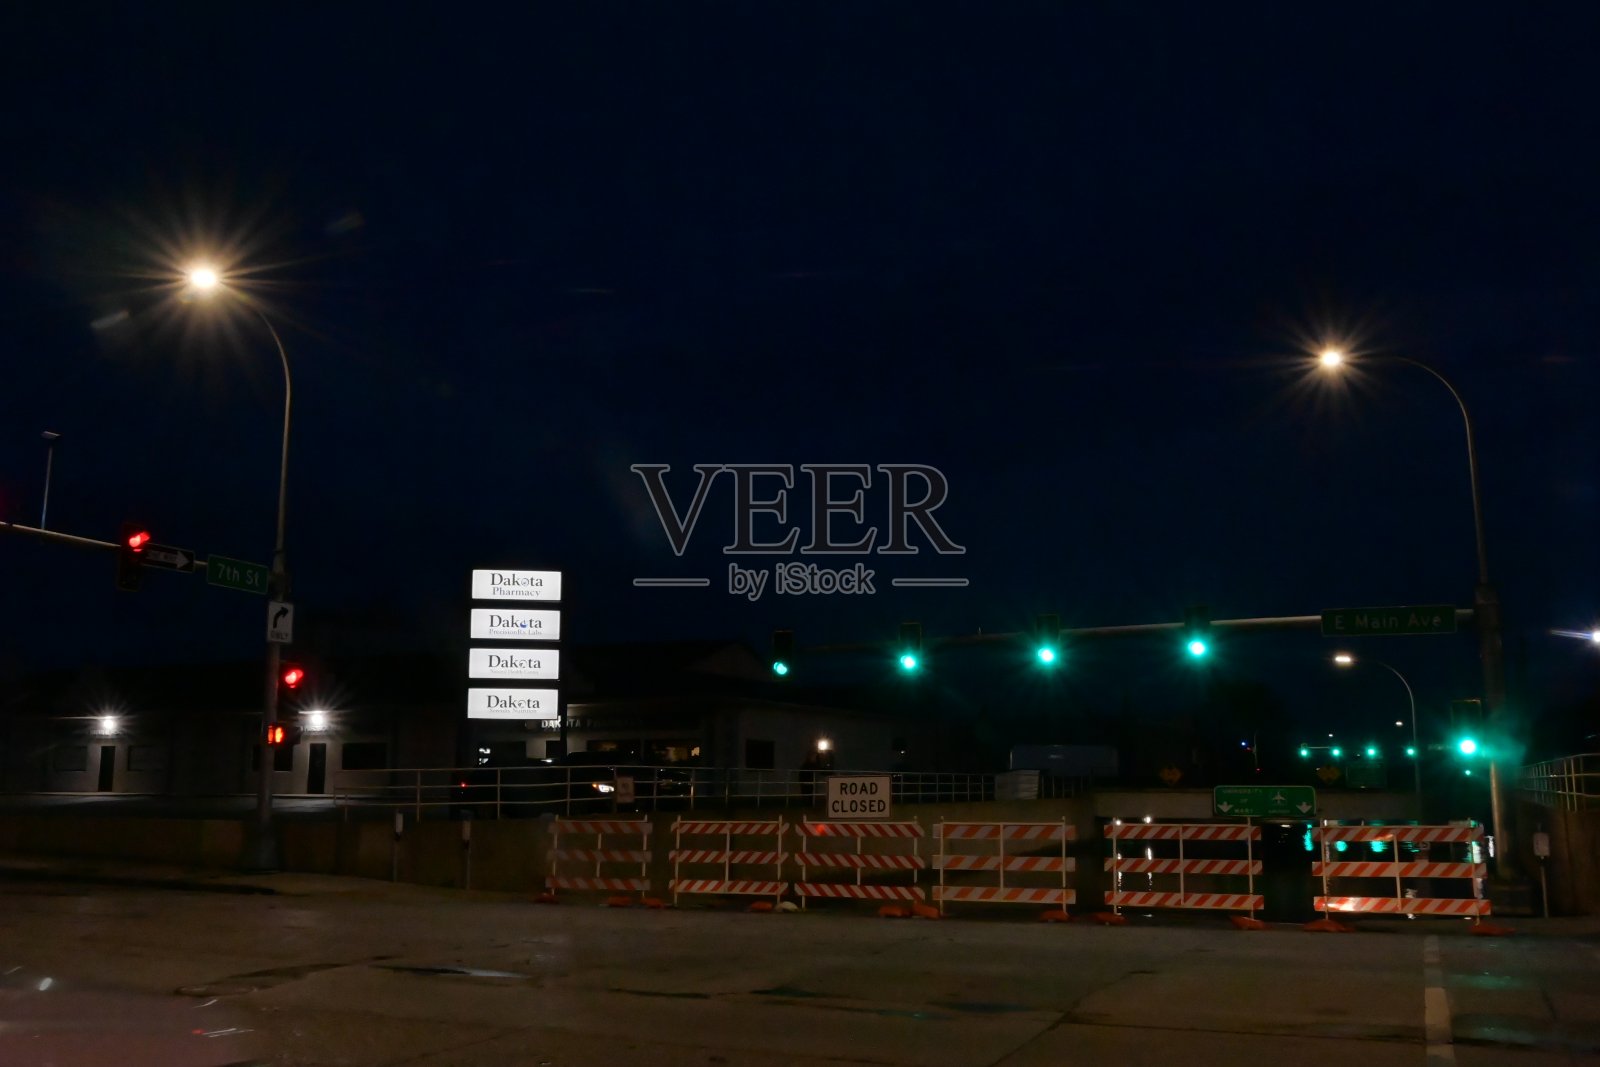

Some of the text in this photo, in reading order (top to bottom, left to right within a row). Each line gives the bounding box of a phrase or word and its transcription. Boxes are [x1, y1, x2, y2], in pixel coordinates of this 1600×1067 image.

[217, 563, 260, 587] 7th St
[490, 572, 543, 587] Dakota
[492, 587, 541, 597] Pharmacy
[489, 614, 542, 629] Dakota
[1335, 610, 1442, 630] E Main Ave
[487, 654, 541, 669] Dakota
[486, 694, 541, 709] Dakota
[840, 782, 878, 795] ROAD
[832, 799, 886, 813] CLOSED
